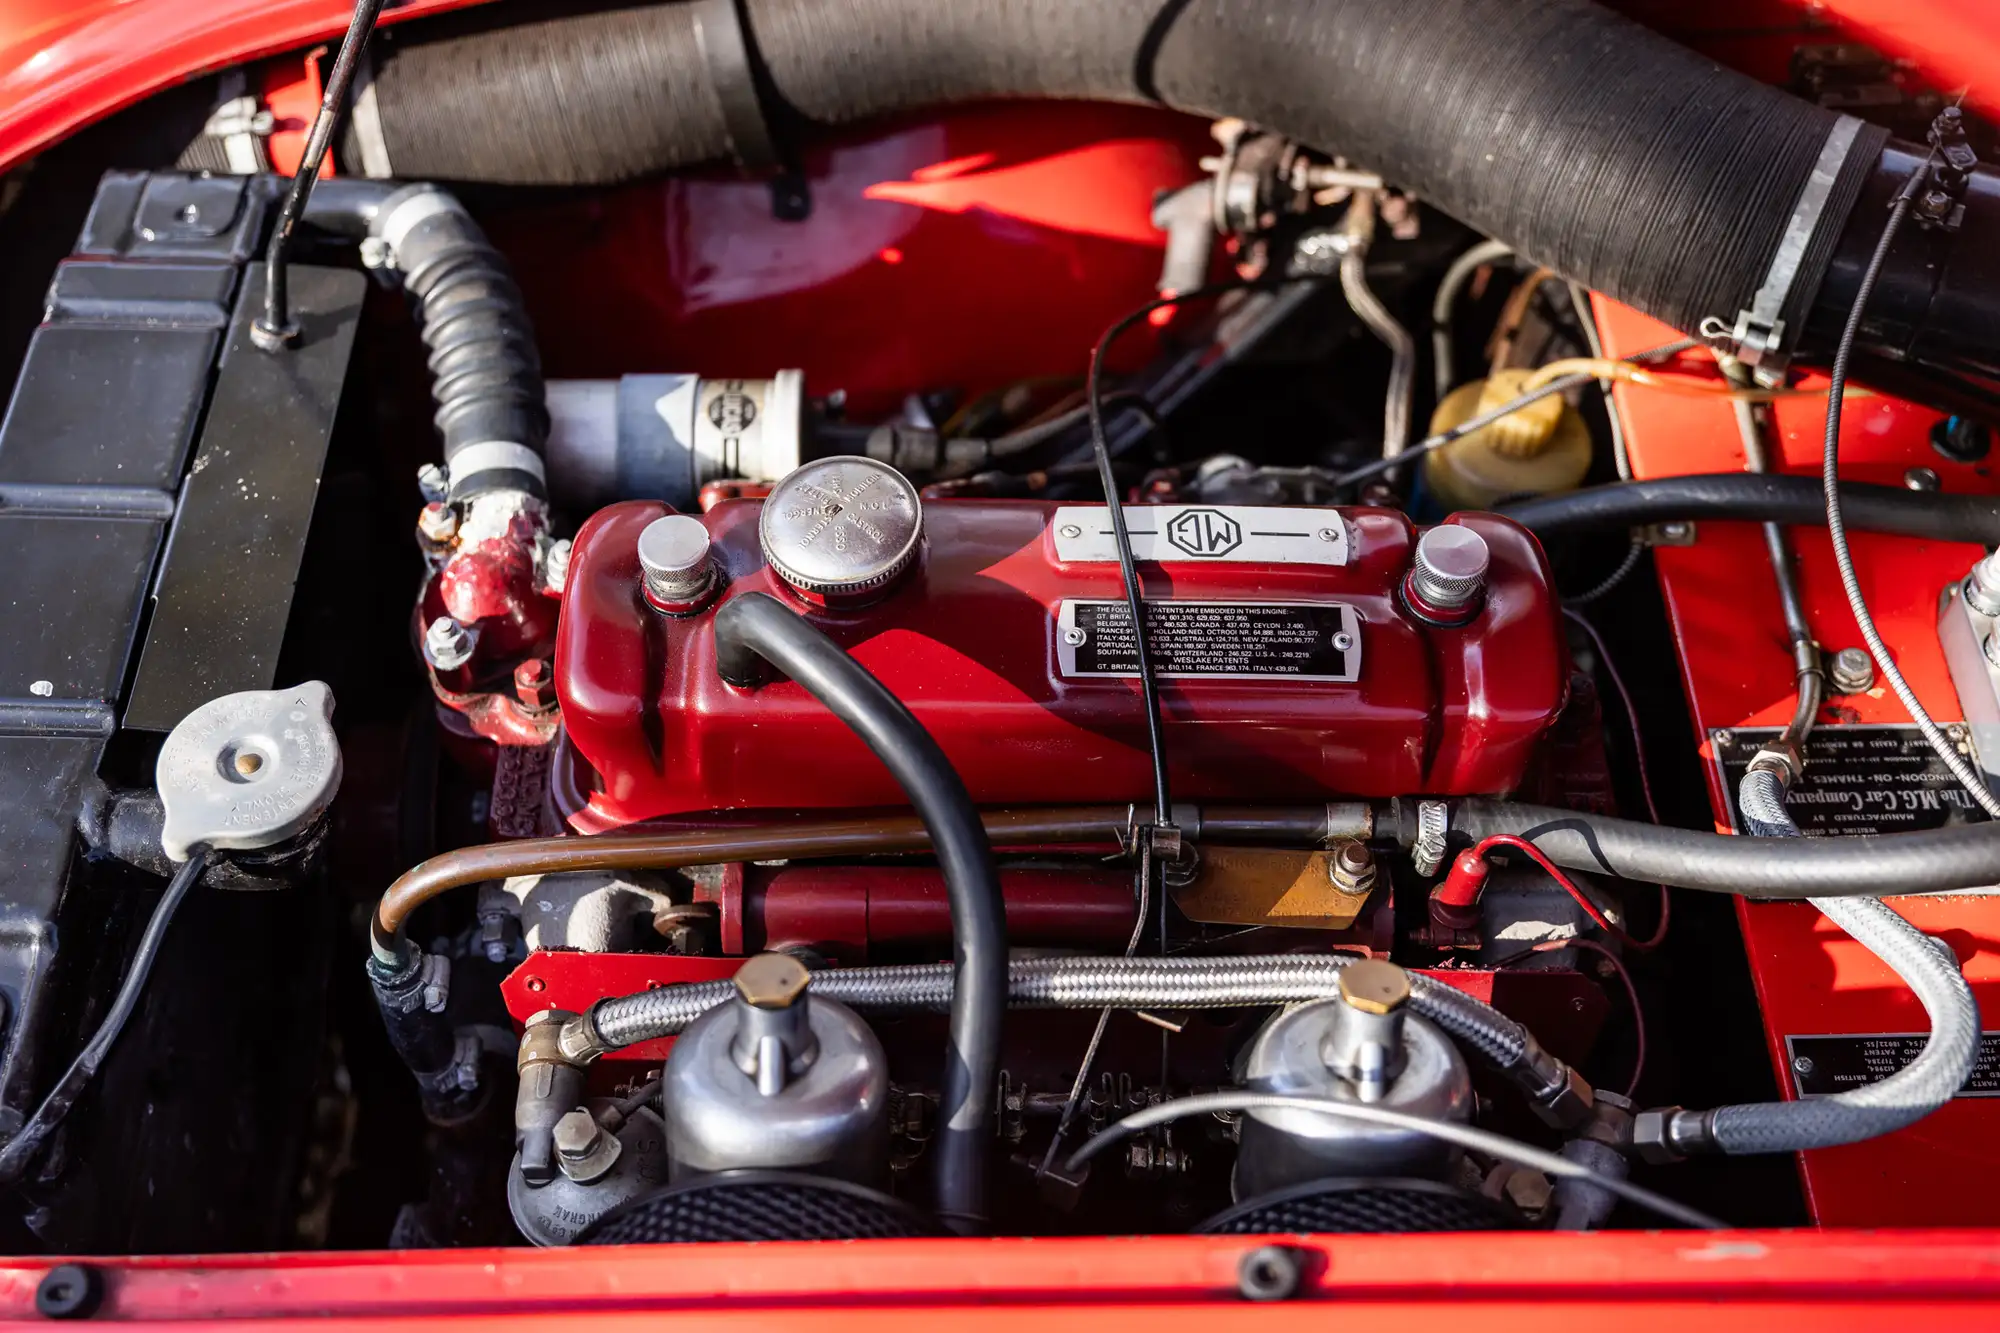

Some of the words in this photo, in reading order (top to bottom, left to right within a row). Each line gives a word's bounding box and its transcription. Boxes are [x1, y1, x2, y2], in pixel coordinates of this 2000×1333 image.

[1177, 513, 1232, 551] MG
[1784, 788, 1863, 811] Company
[1864, 790, 1897, 810] Car
[1897, 790, 1941, 810] M.G.
[1940, 790, 1975, 809] The
[1812, 814, 1825, 823] BY
[1834, 813, 1915, 821] MANUFACTURED
